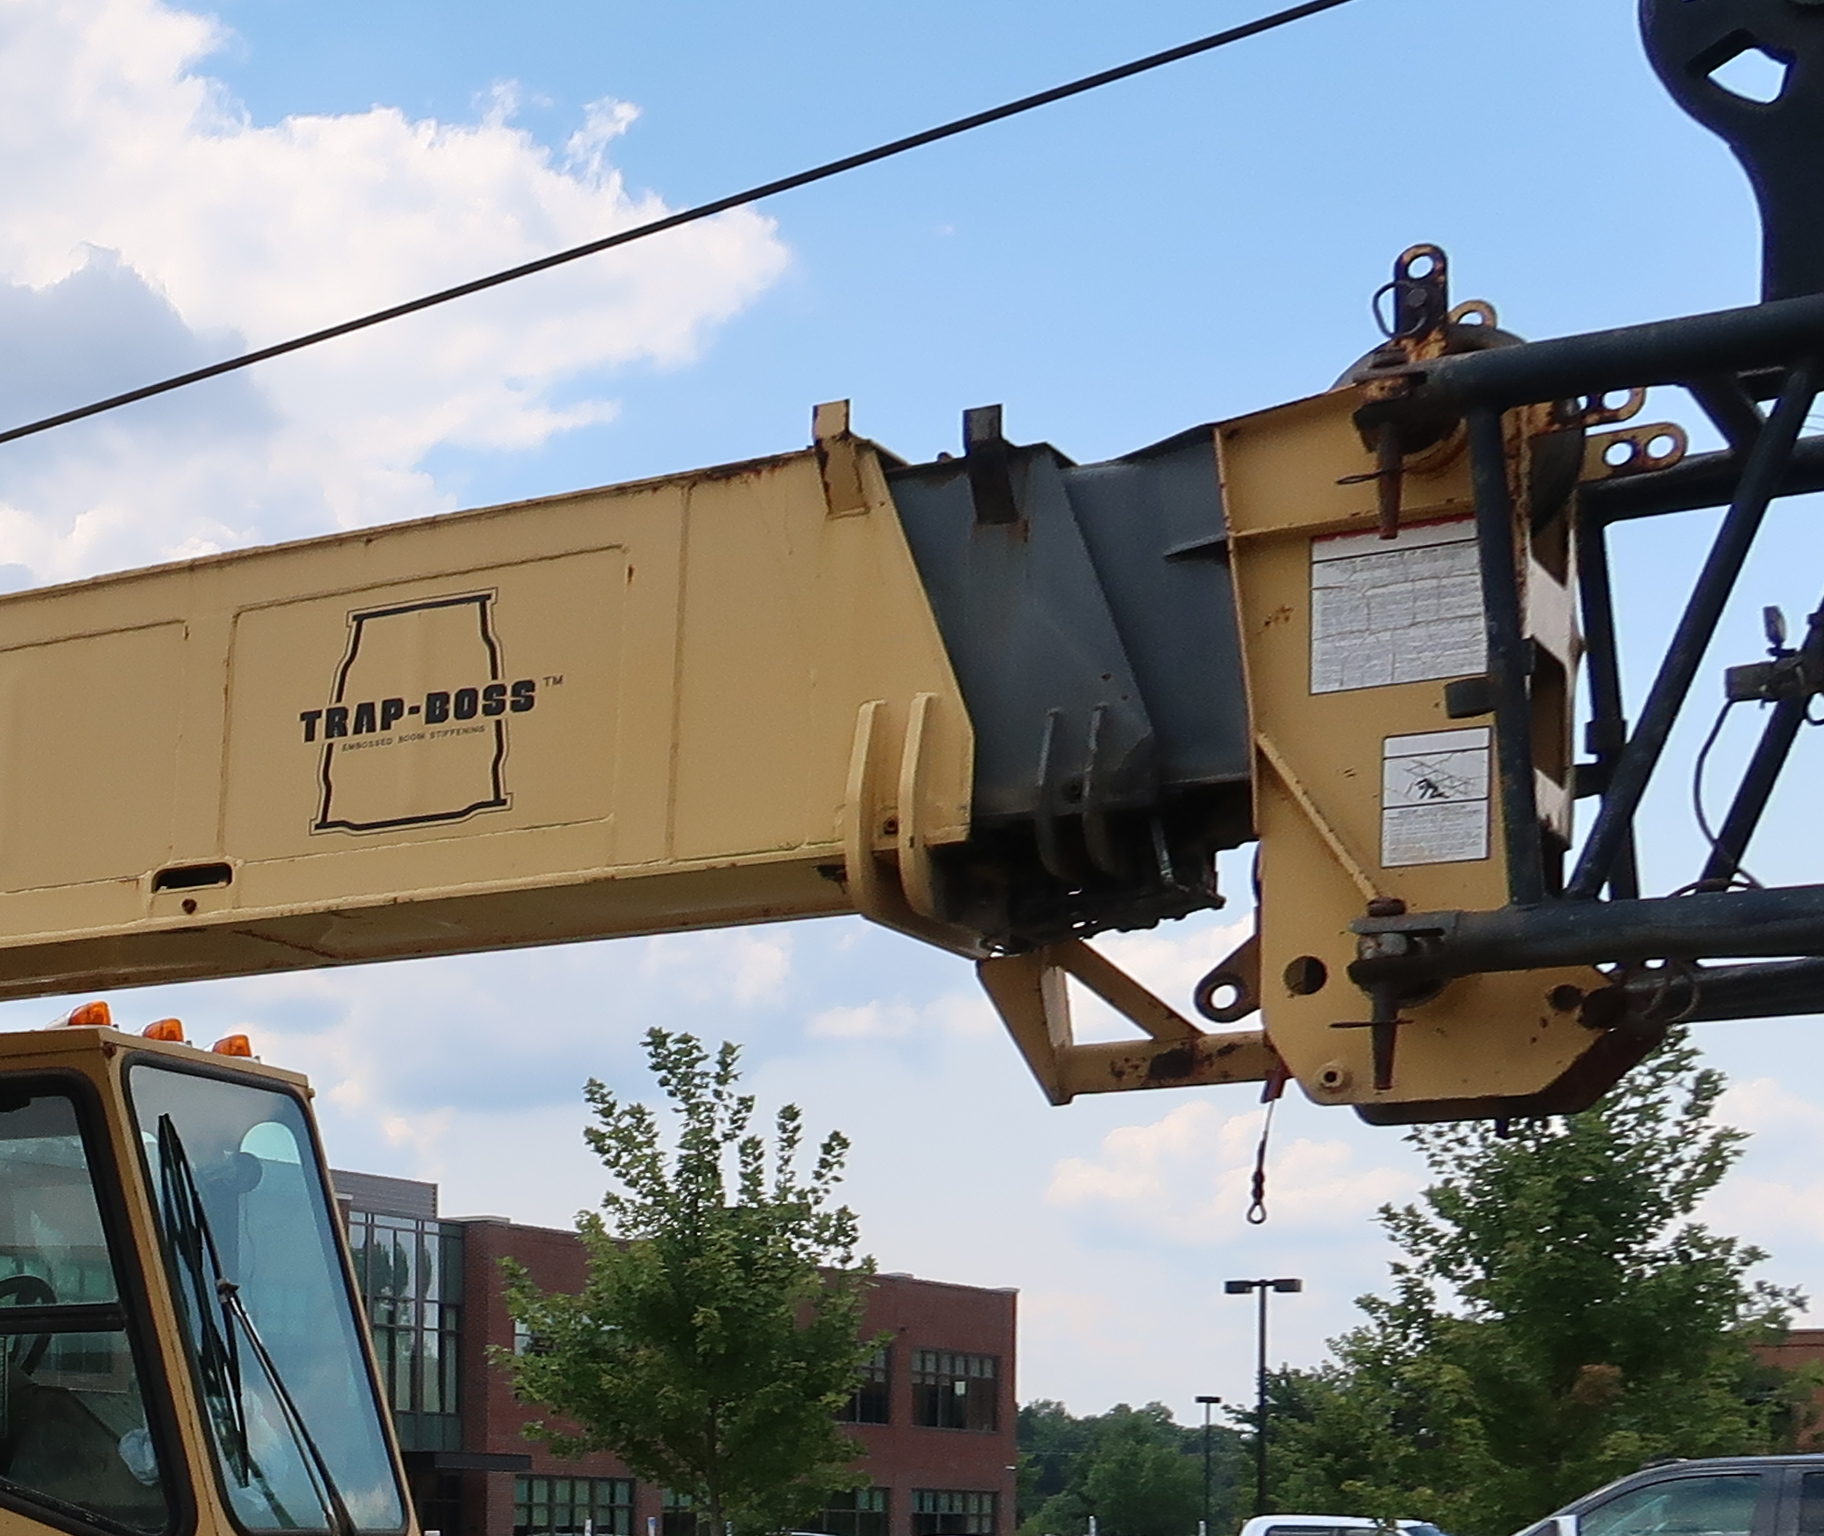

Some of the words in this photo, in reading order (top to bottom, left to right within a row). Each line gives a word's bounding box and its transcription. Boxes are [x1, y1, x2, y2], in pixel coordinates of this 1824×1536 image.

[299, 679, 536, 743] TRAP-BOSS
[341, 737, 394, 752] EMBOSSED
[398, 732, 426, 745] BOOM
[430, 724, 486, 741] STIFFENING
